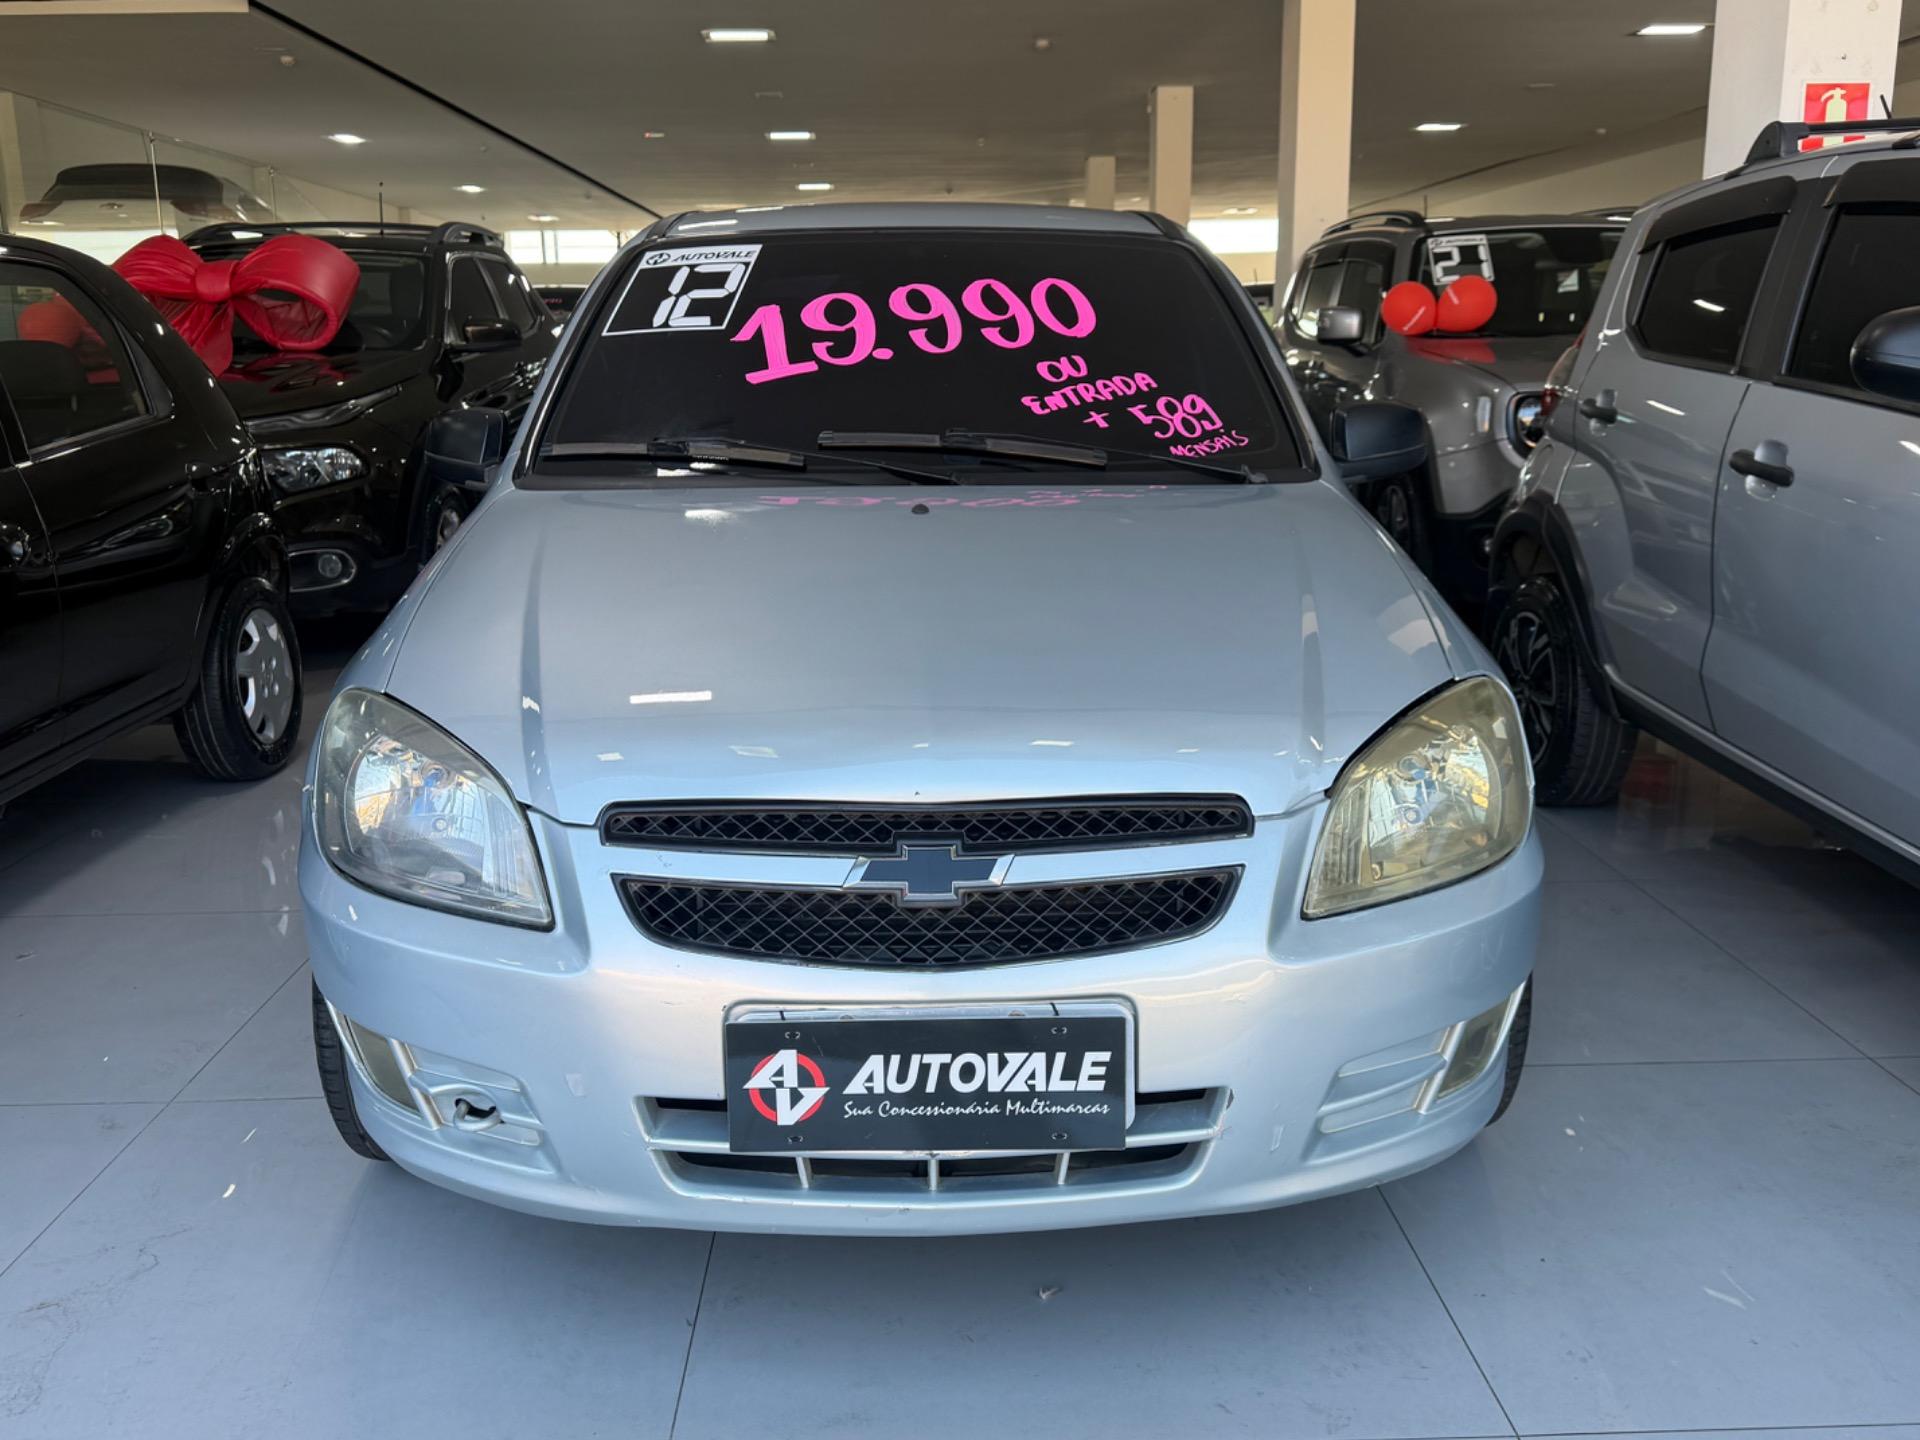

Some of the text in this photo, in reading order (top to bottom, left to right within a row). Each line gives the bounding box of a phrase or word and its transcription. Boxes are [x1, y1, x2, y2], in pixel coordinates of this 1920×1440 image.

[672, 250, 757, 263] AUTOVALE
[652, 263, 746, 328] 12
[730, 278, 1097, 384] 19.990
[1035, 354, 1089, 383] OU
[1020, 372, 1158, 416] ENTRADA
[1082, 393, 1223, 439] + 589
[842, 1051, 1112, 1095] AUTOVALE
[843, 1097, 1111, 1119] Sua Concessionária Multimarcas
